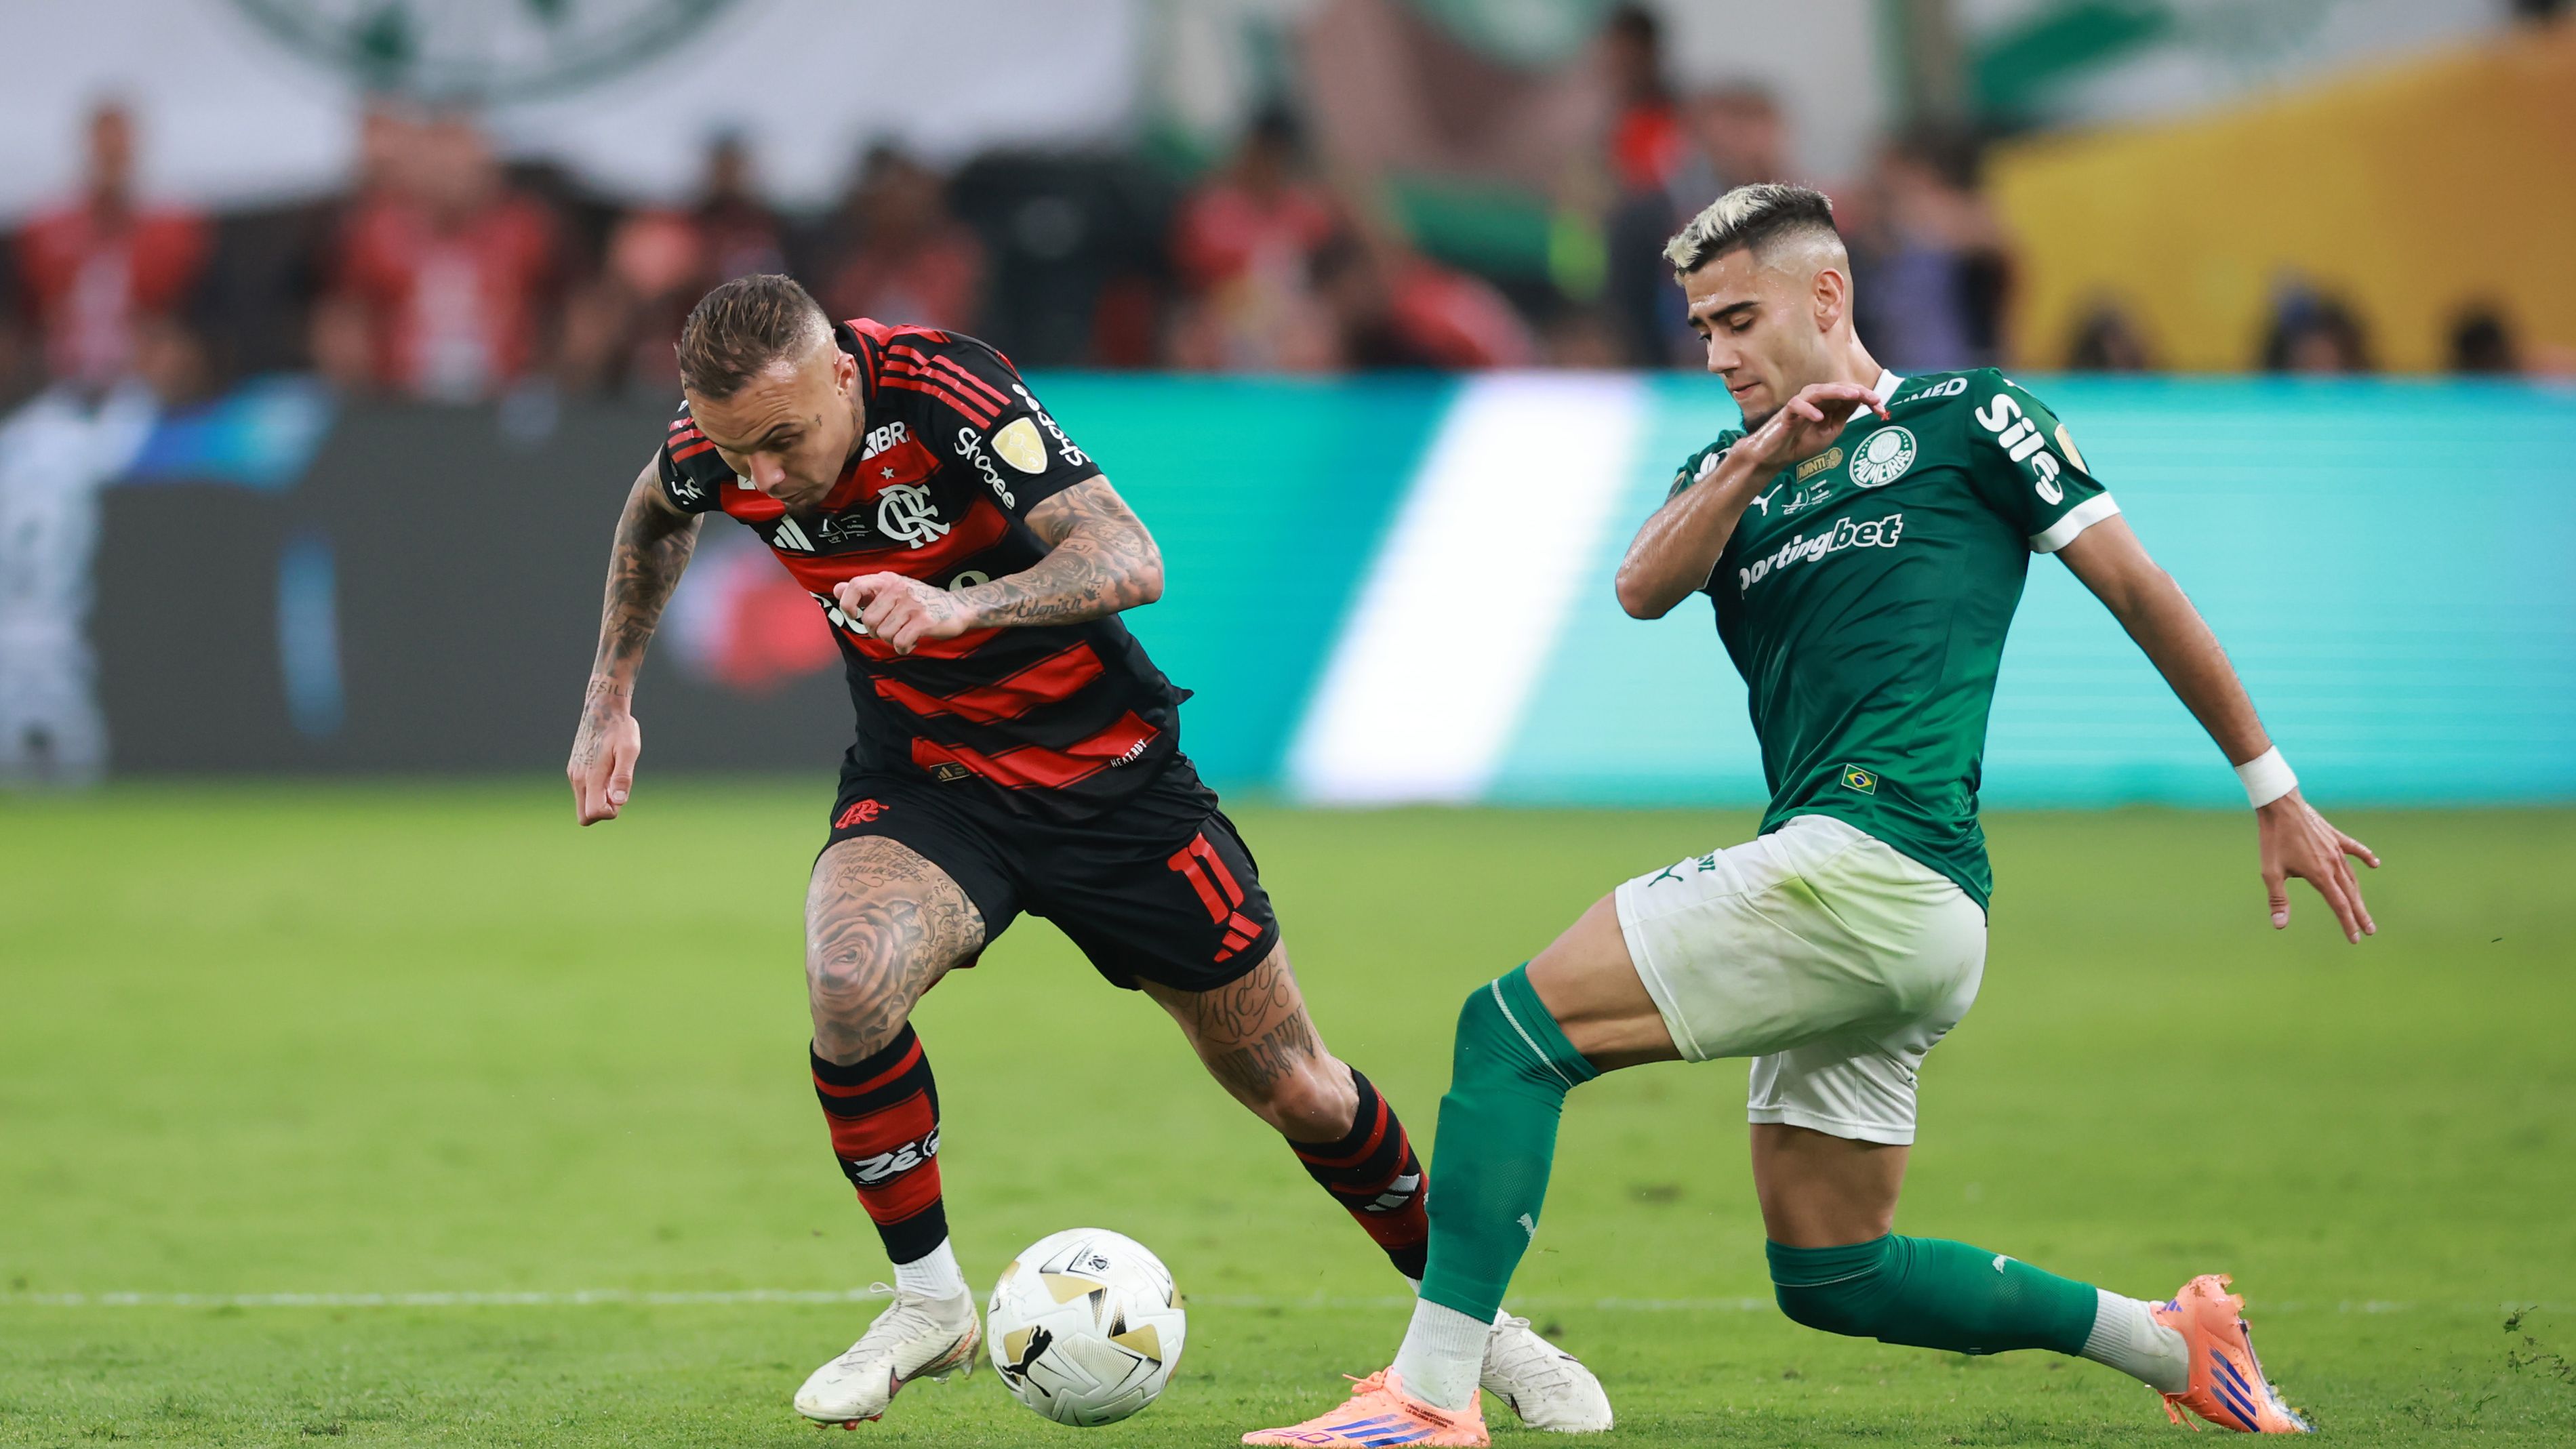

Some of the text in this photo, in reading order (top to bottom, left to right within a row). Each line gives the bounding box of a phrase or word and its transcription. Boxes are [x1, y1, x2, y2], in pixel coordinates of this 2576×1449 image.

[875, 420, 910, 453] BR
[1011, 383, 1091, 467] Shopee
[953, 426, 1015, 510] Shopee
[1854, 449, 1912, 485] PALMEIRAS
[1739, 513, 1904, 600] portingbet
[1110, 738, 1148, 769] HEAT.RDY
[1167, 831, 1245, 925] 11
[853, 1141, 924, 1182] Zé
